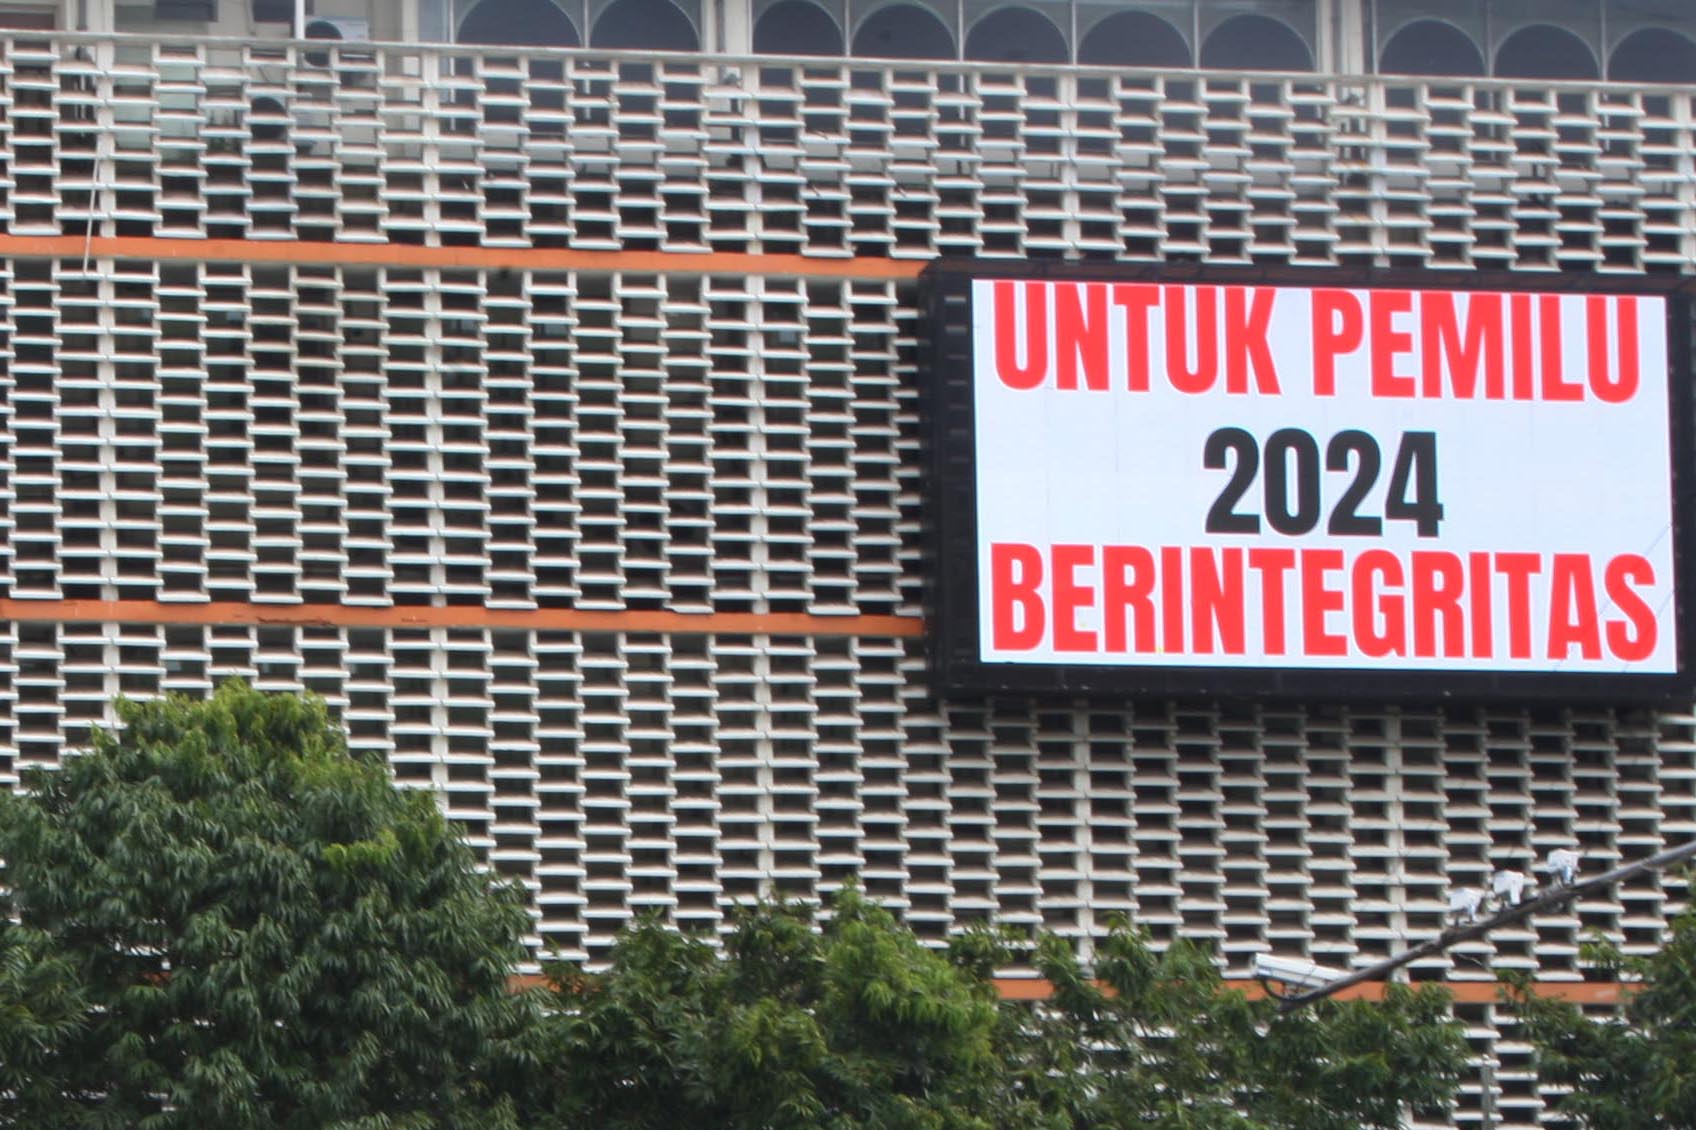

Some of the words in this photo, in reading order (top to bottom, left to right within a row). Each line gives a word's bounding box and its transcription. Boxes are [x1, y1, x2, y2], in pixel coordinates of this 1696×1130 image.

[992, 280, 1280, 394] UNTUK
[1310, 288, 1638, 403] PEMILU
[1203, 427, 1444, 537] 2024
[989, 542, 1658, 661] BERINTEGRITAS
